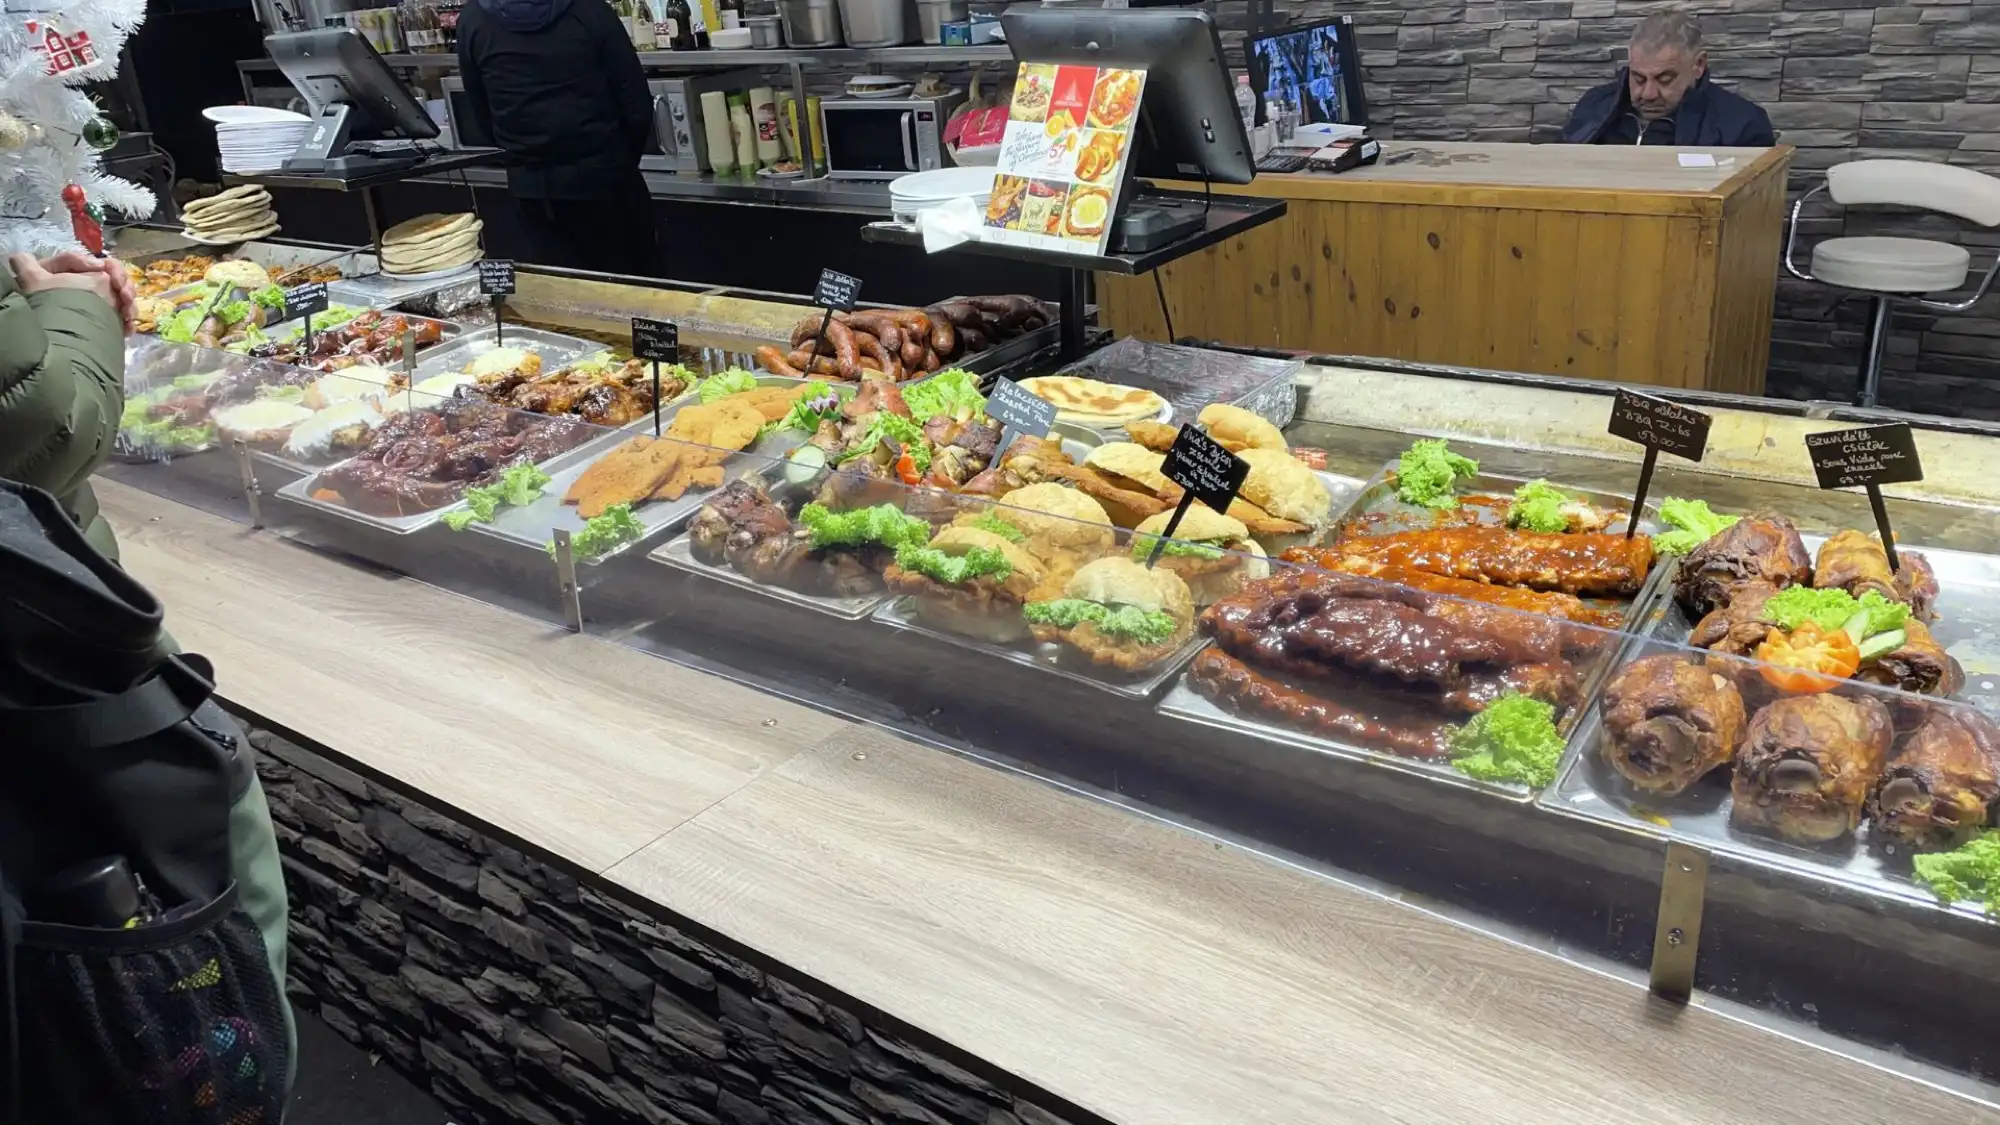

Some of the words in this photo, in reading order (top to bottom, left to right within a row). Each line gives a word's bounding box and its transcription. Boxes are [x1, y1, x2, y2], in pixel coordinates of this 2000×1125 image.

[1622, 393, 1652, 410] BBQ
[1623, 409, 1653, 429] BBQ
[1656, 419, 1690, 437] Ribs
